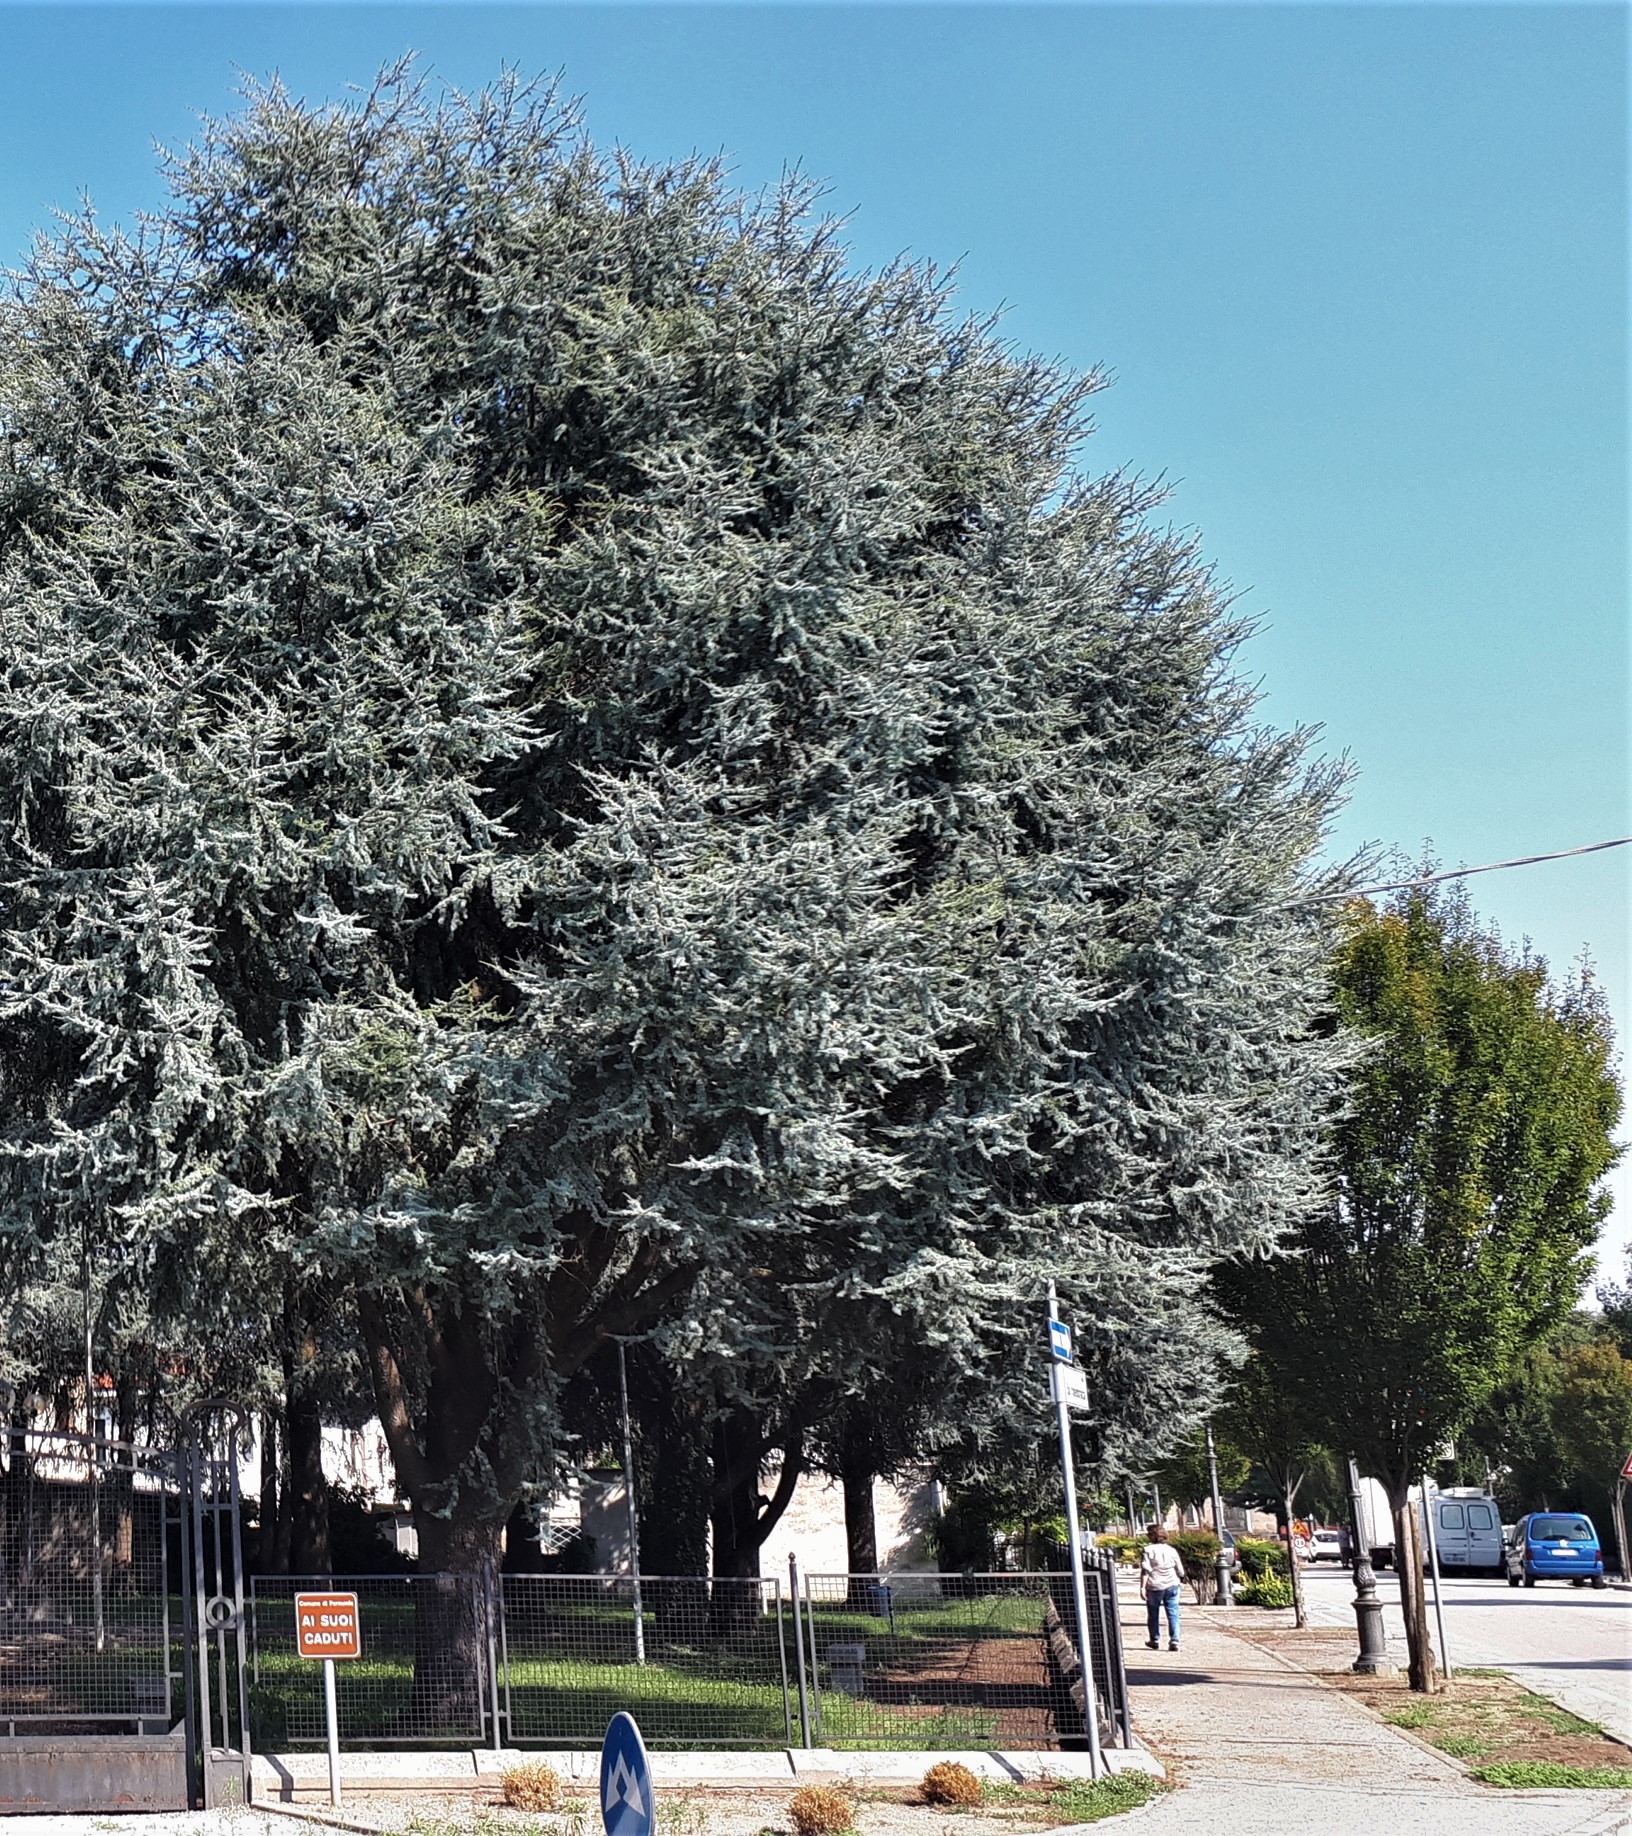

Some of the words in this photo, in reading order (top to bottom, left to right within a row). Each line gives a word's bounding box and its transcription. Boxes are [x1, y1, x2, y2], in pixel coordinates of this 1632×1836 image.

[301, 1614, 315, 1627] AI
[320, 1614, 353, 1627] SUOI
[304, 1632, 353, 1645] CADUTI
